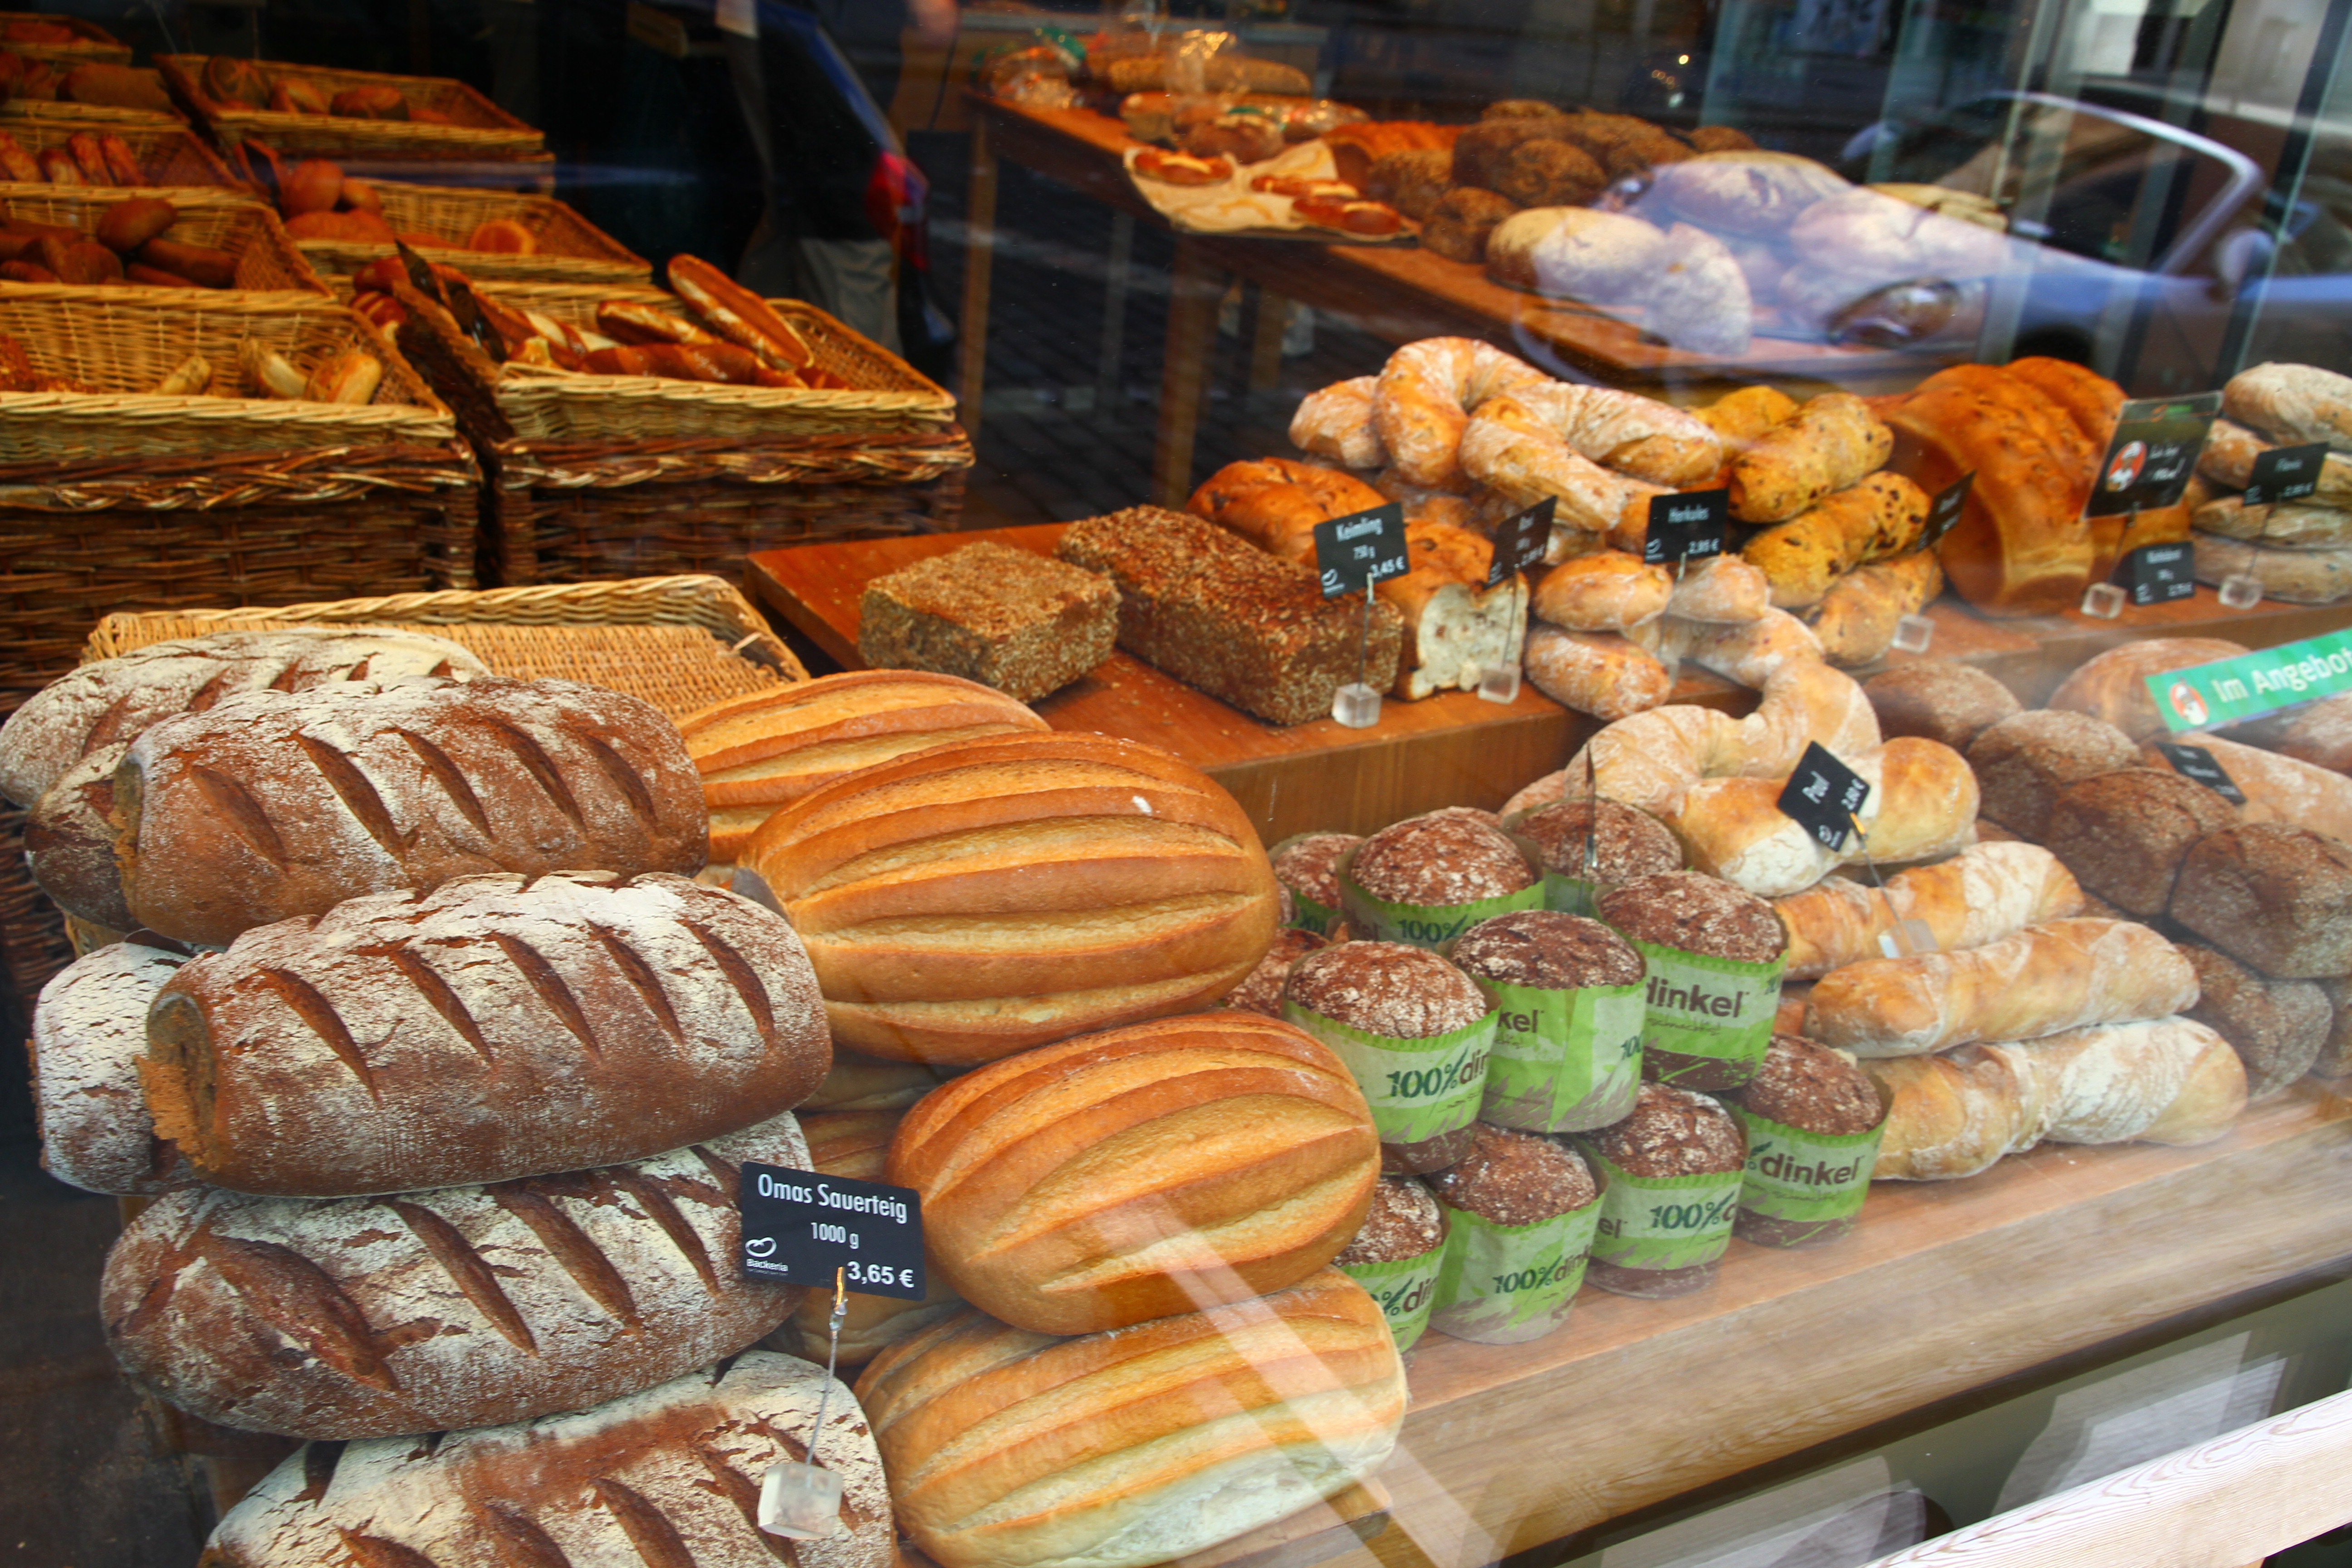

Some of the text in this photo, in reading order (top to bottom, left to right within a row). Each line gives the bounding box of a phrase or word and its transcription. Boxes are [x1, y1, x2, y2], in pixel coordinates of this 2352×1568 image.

[1336, 516, 1383, 542] Keimling
[1396, 556, 1405, 570] €
[2211, 679, 2249, 702] Im
[1760, 1153, 1859, 1186] dinkel
[758, 1174, 907, 1224] Omas Sauerteig
[1650, 1191, 1735, 1229] 100%
[811, 1222, 859, 1250] 1000 g
[746, 1259, 789, 1272] Backeria
[847, 1261, 914, 1288] 3,65 €
